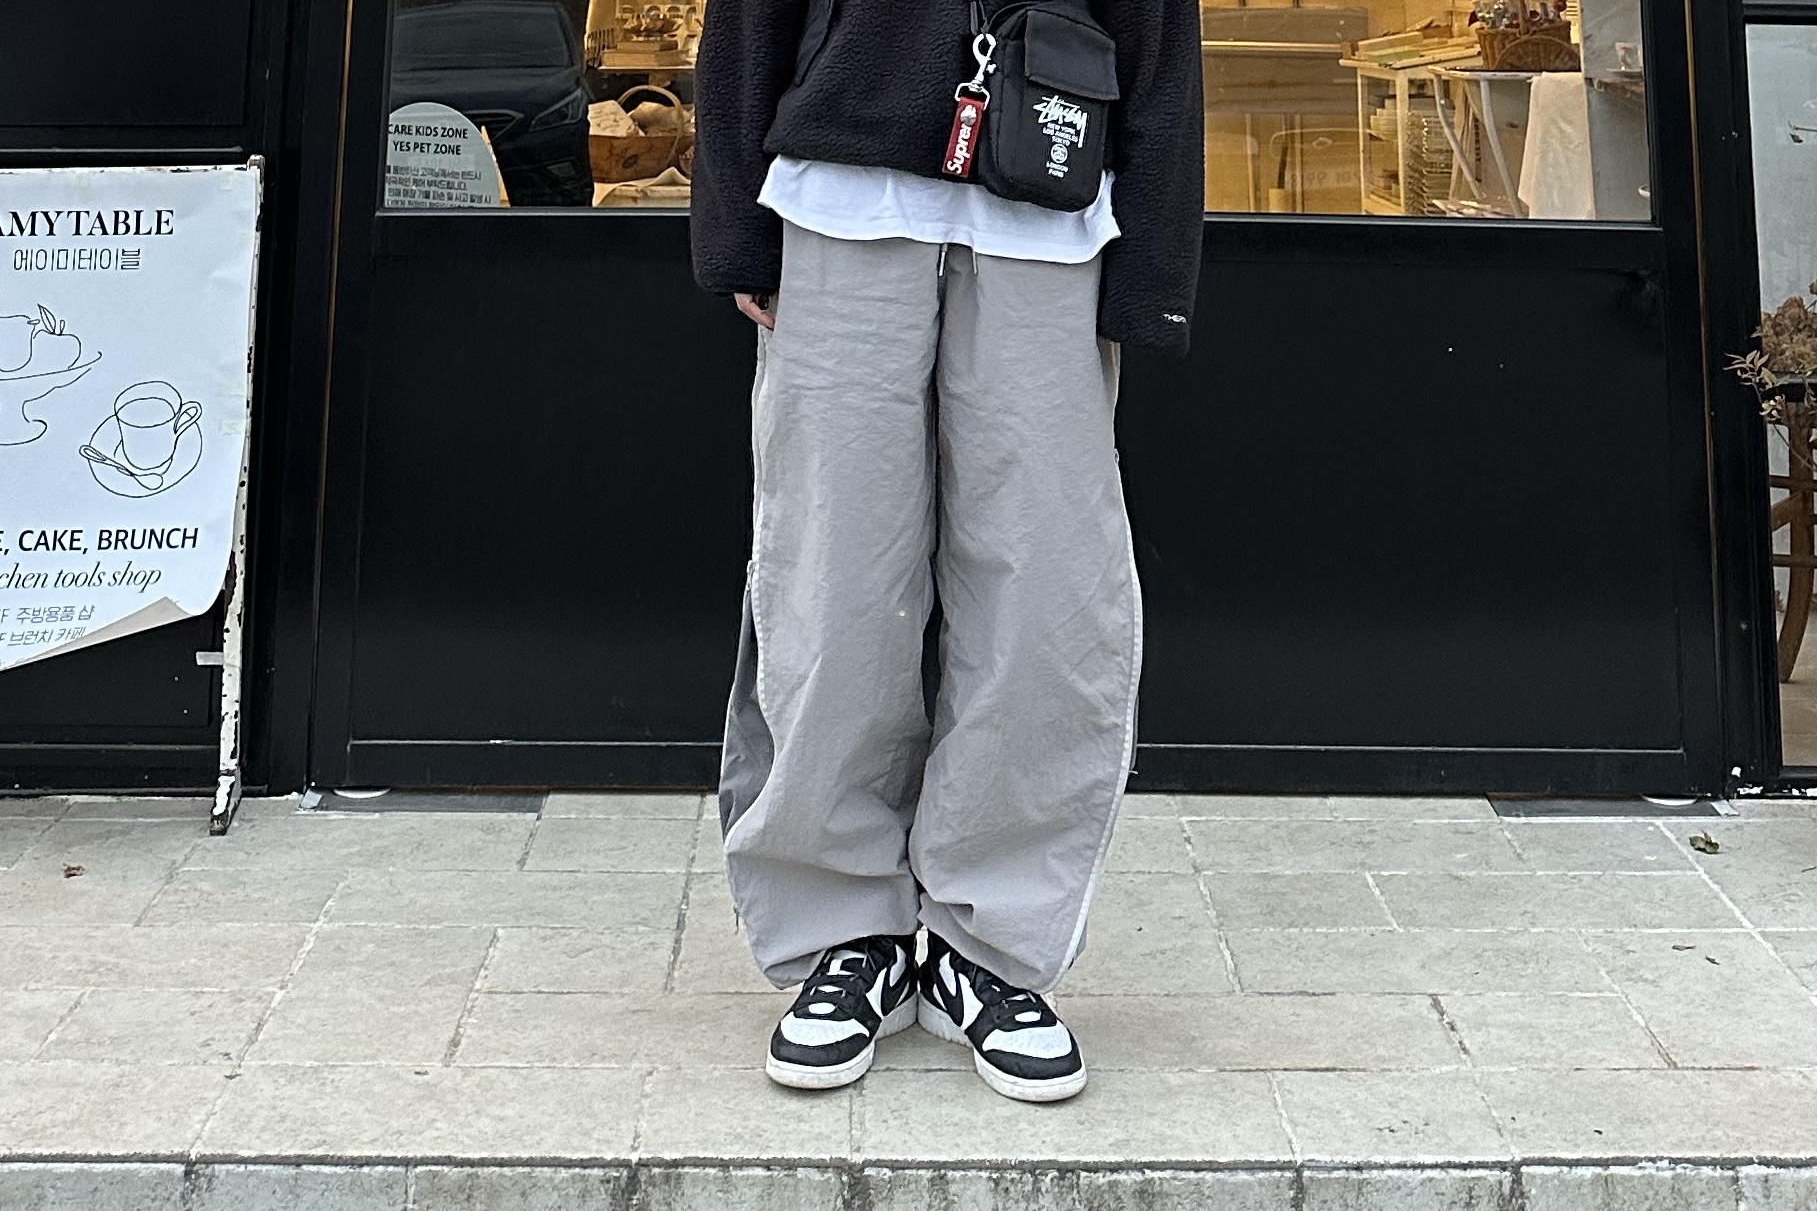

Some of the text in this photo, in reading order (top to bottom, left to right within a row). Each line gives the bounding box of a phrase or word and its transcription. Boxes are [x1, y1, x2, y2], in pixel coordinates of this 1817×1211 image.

[415, 125, 438, 137] KIDS
[441, 127, 469, 139] ZONE
[393, 140, 462, 156] YES PET ZONE
[13, 248, 141, 271] 에이미테이블
[18, 529, 88, 555] CAKE,
[97, 527, 199, 551] BRUNCH
[53, 561, 103, 588] tools
[108, 561, 162, 594] shop
[16, 606, 76, 624] 주방용품
[78, 604, 95, 621] 샵
[7, 628, 53, 647] 브런치
